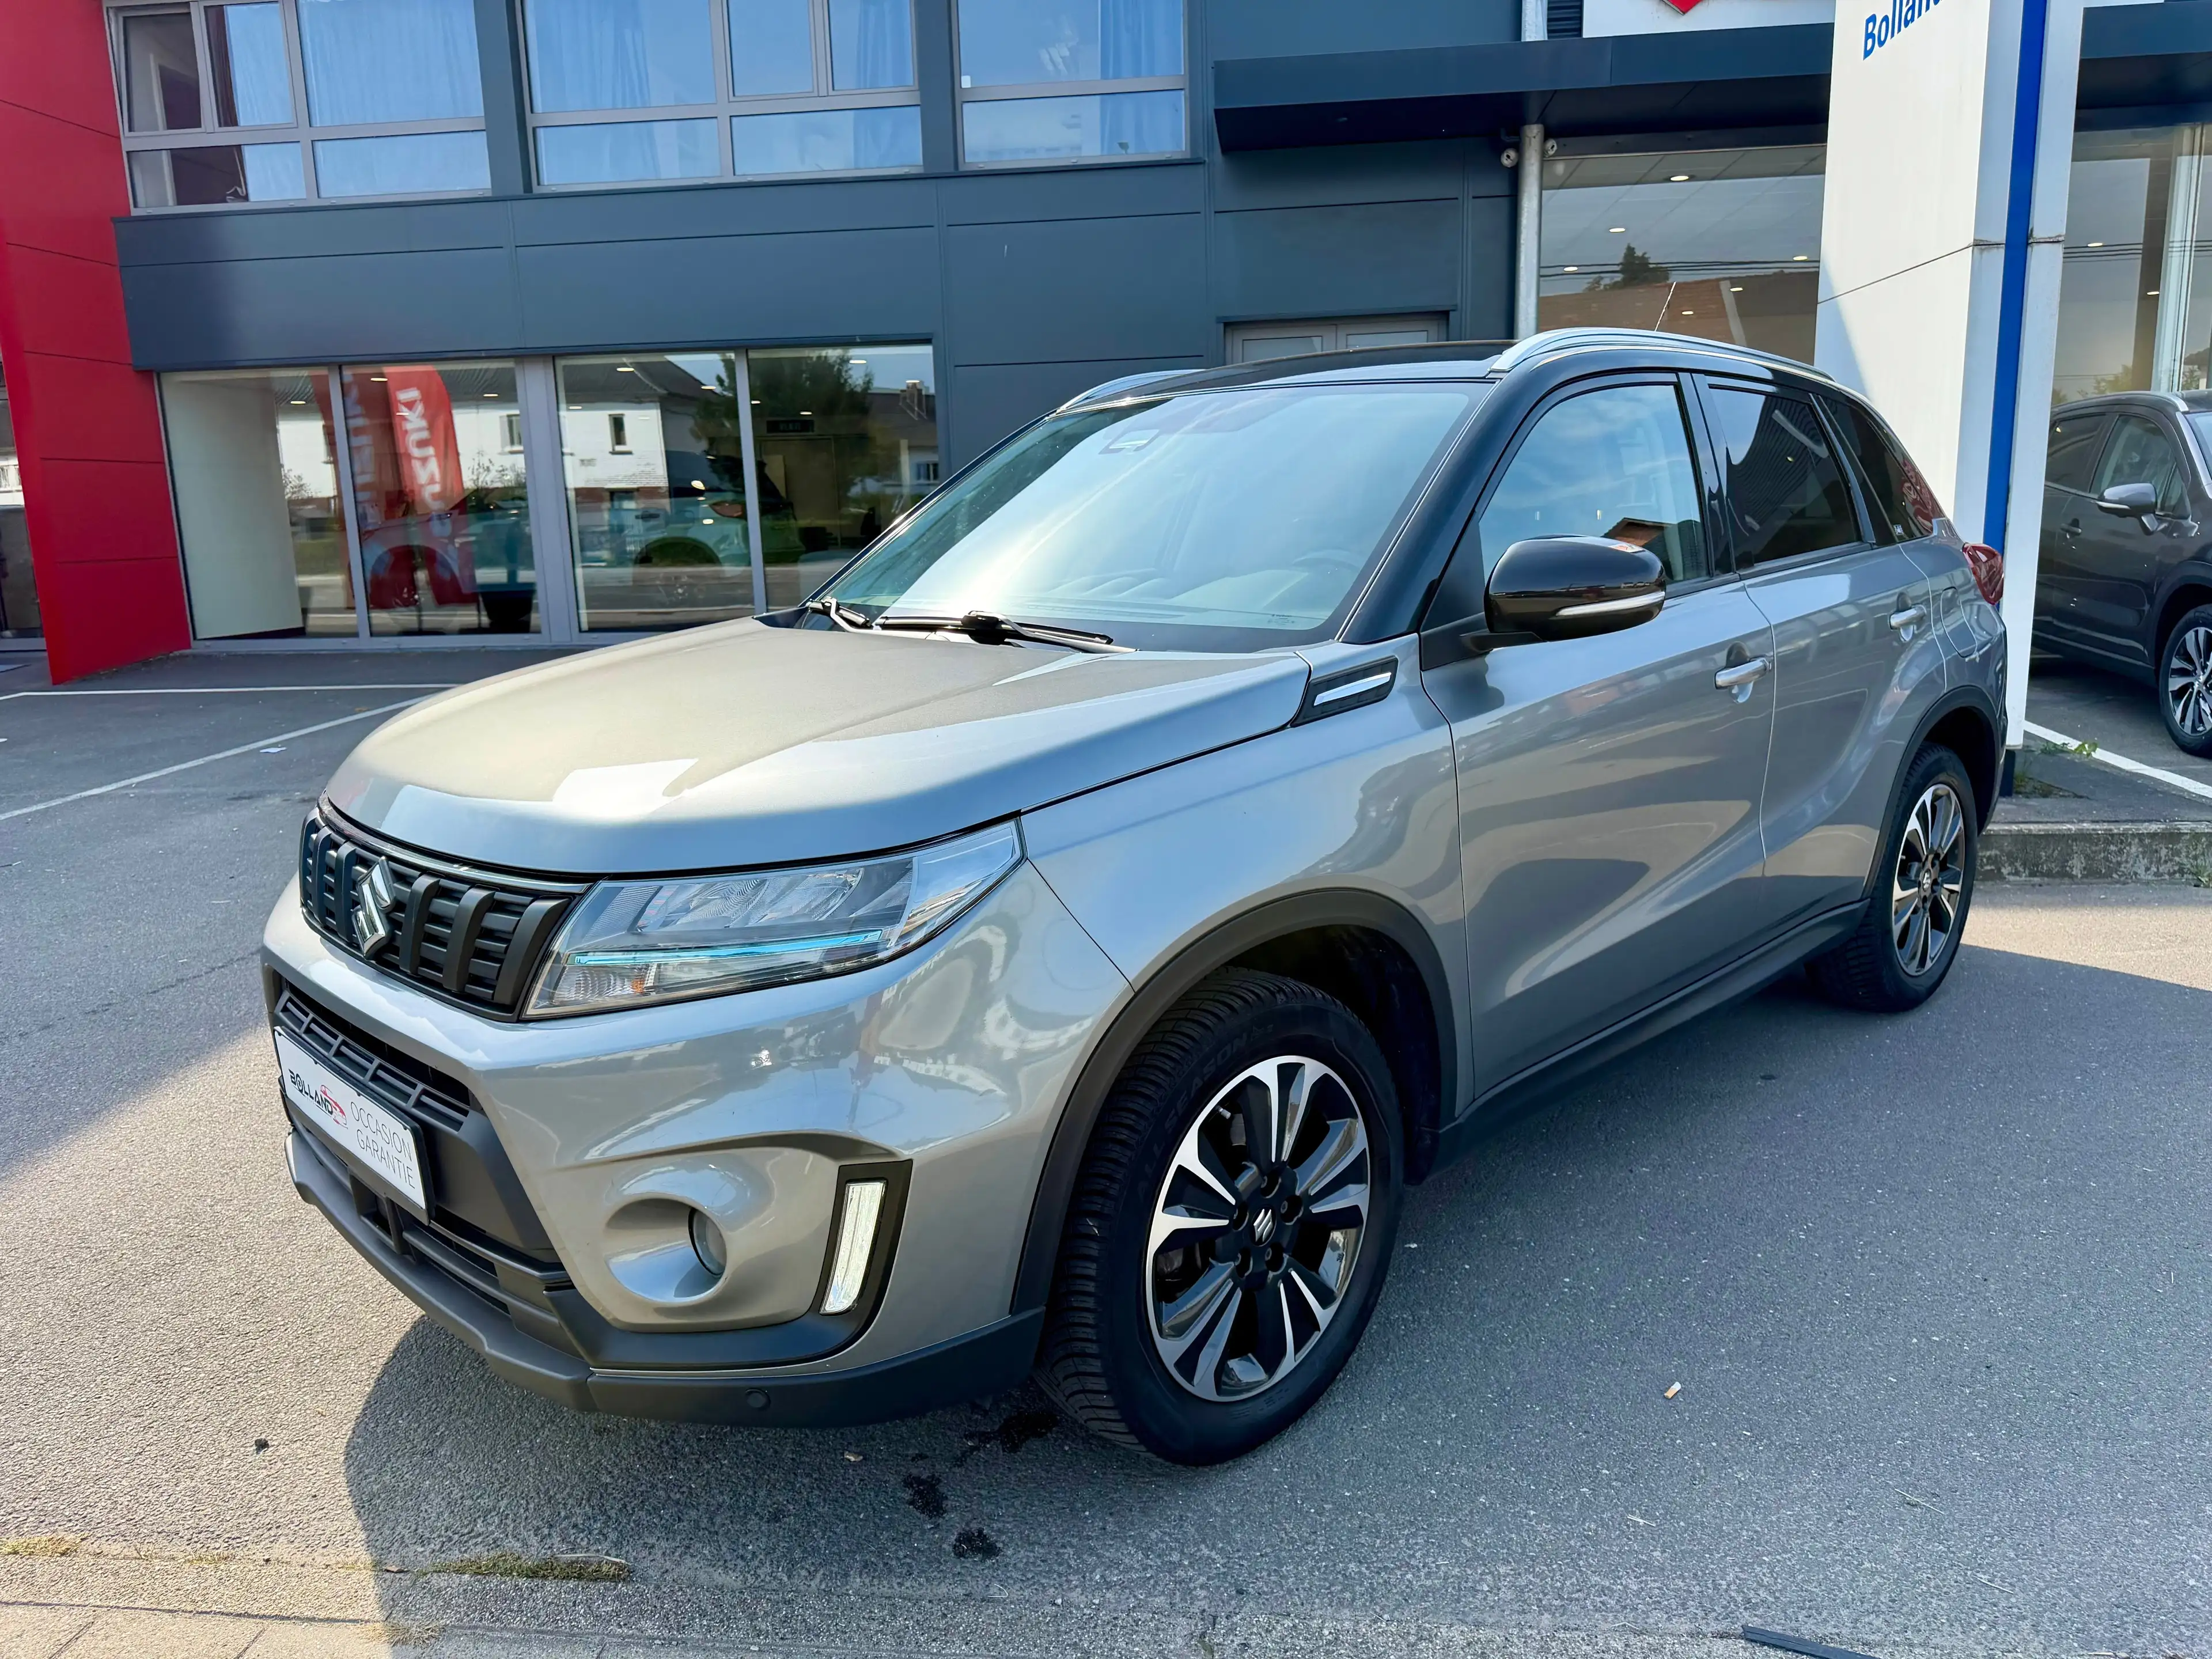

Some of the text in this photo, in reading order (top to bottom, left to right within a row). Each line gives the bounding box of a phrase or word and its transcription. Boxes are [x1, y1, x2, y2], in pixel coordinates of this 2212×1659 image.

[288, 1069, 333, 1115] BOLLAND
[350, 1101, 412, 1162] OCCASION
[357, 1129, 415, 1190] GARANTIE
